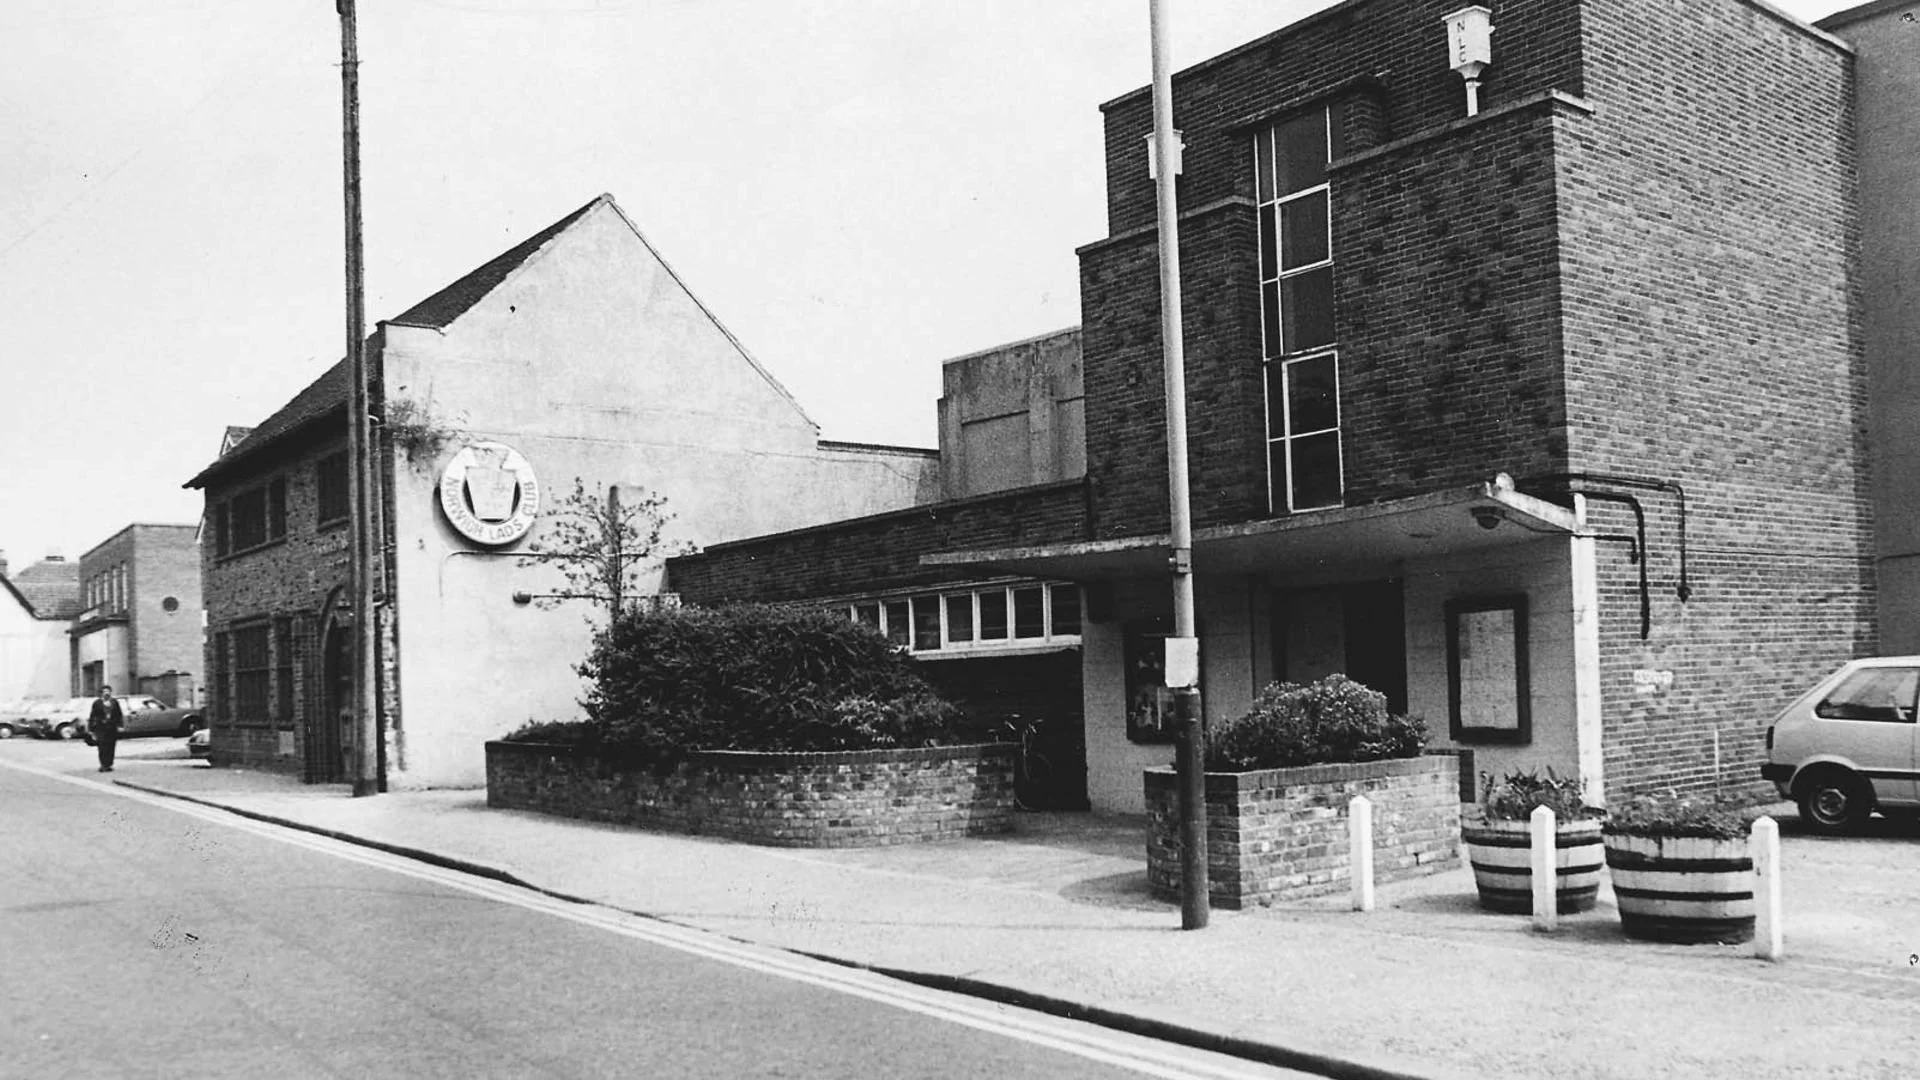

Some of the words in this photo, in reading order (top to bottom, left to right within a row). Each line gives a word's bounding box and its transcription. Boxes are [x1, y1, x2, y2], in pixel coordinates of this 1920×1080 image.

[1457, 20, 1467, 63] NLC
[446, 476, 485, 537] NORWICH
[489, 519, 524, 540] LADS
[522, 481, 537, 517] CLUB
